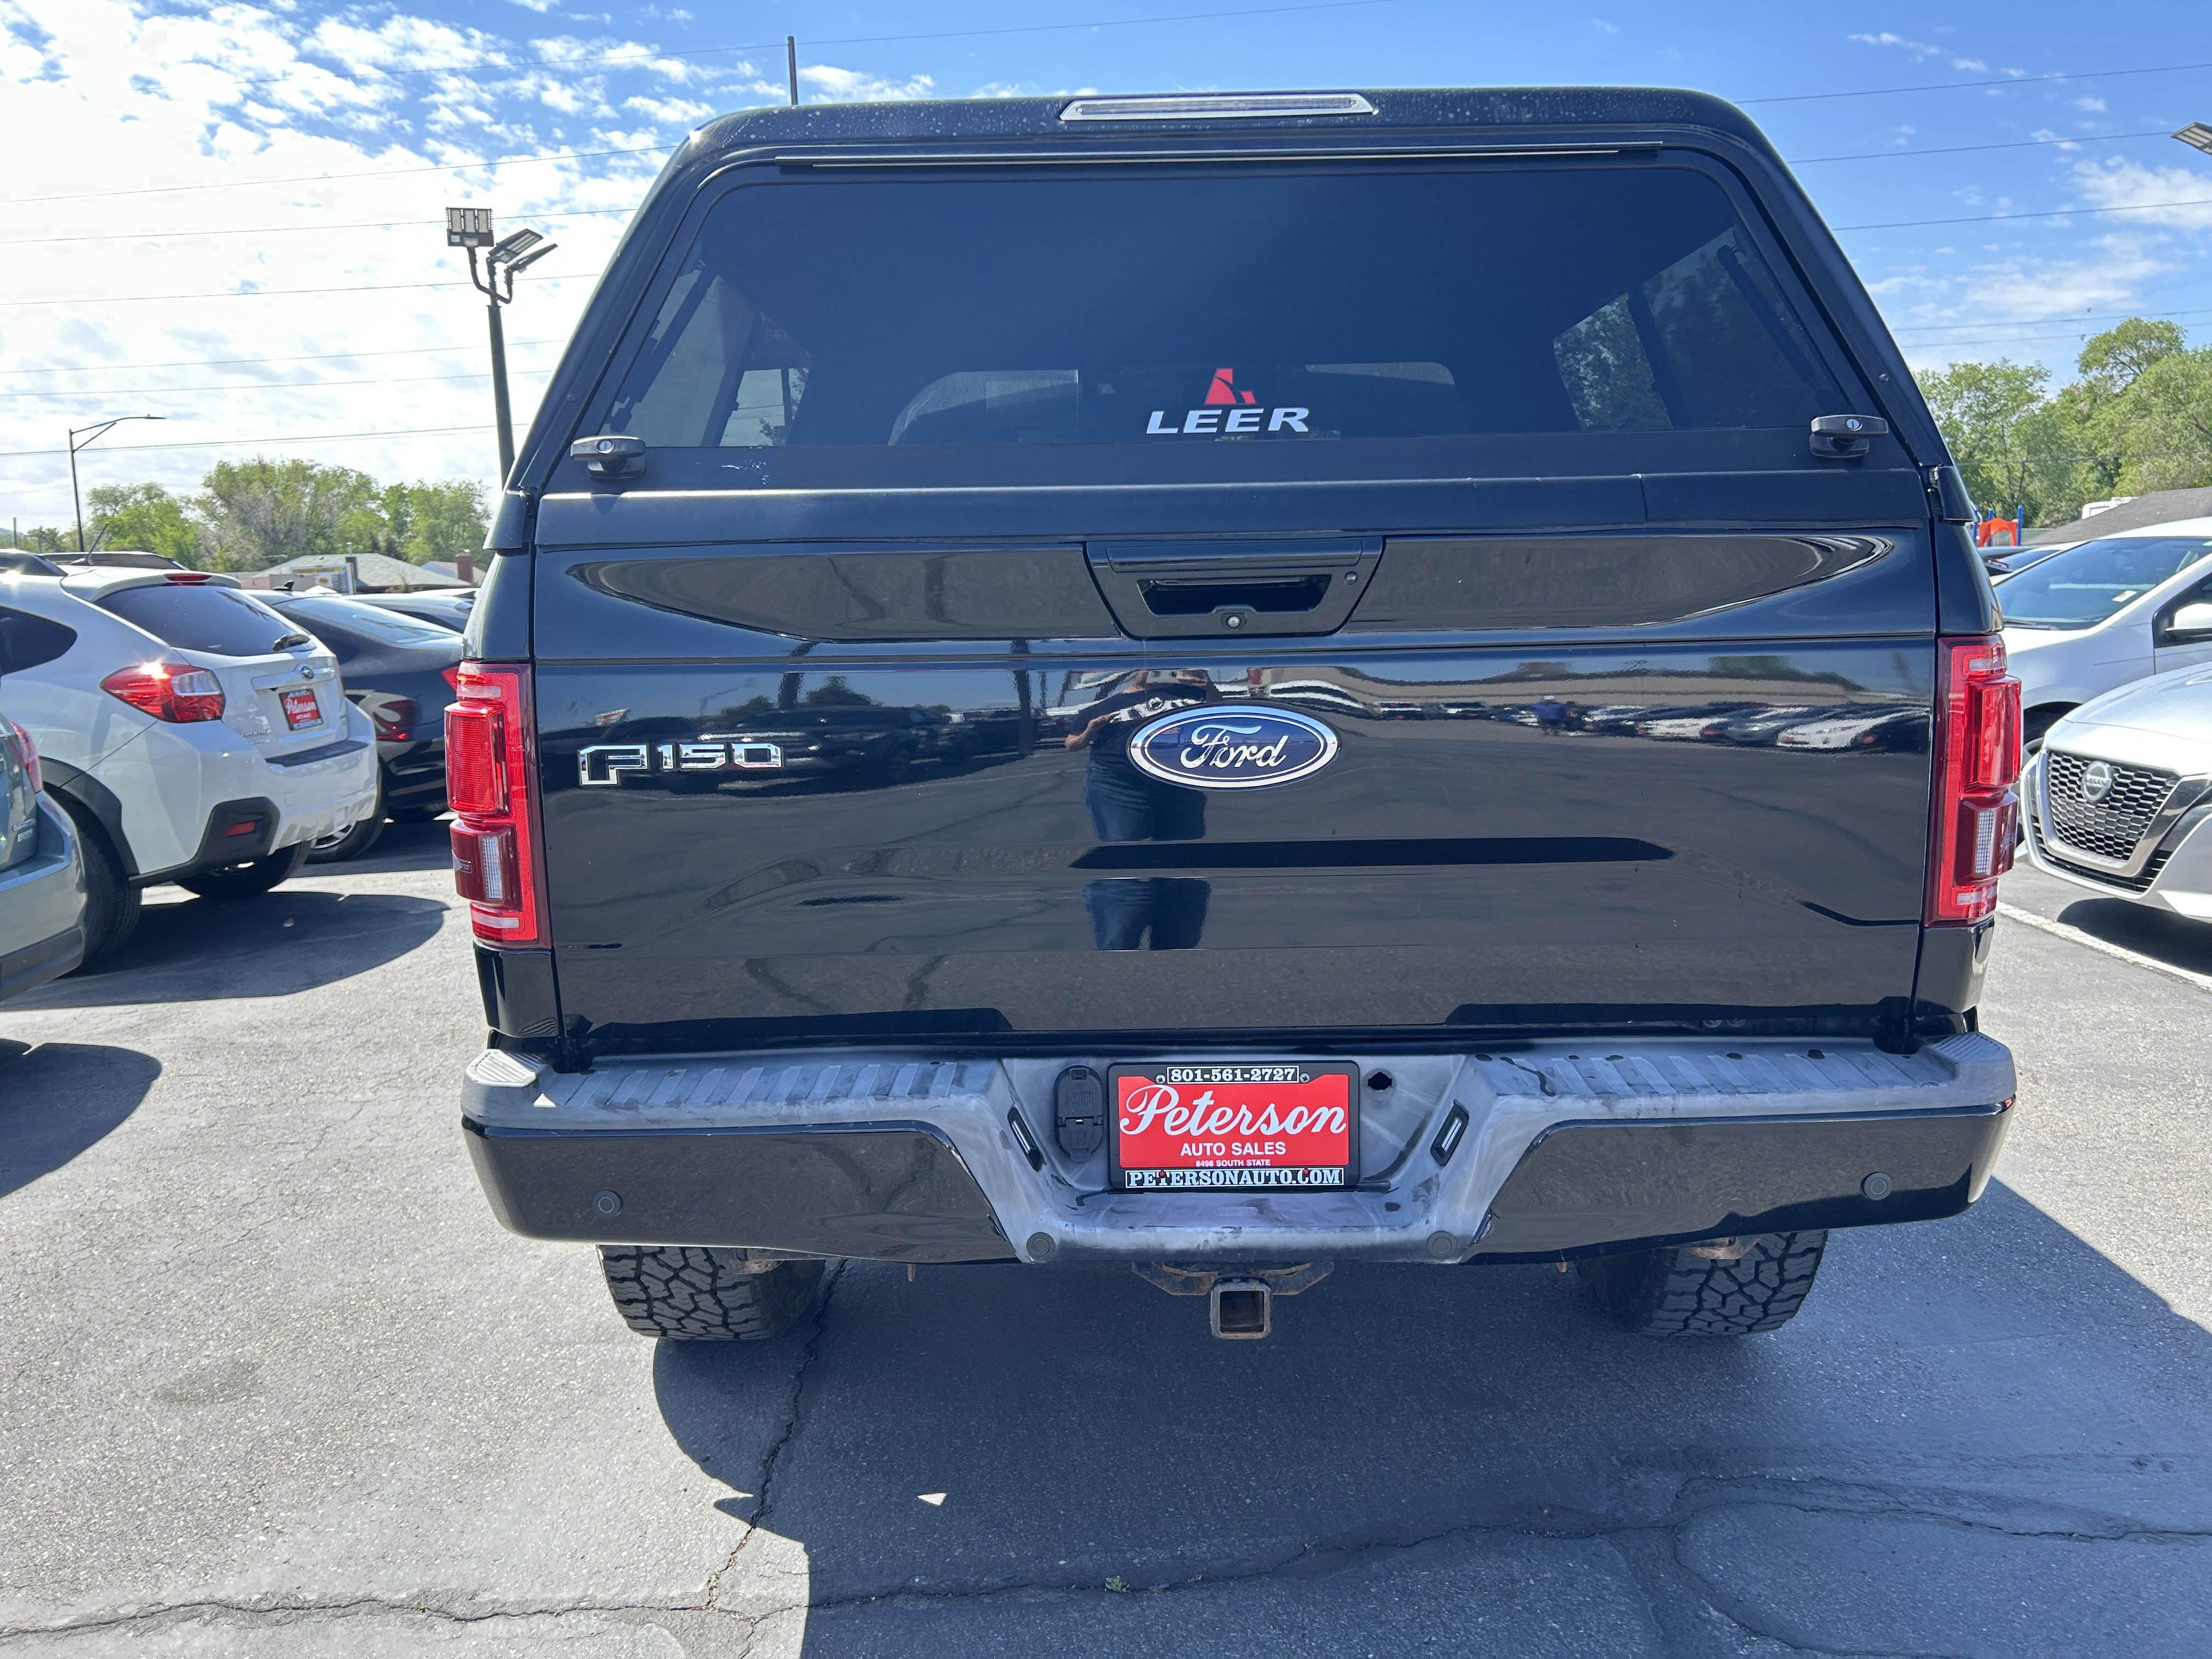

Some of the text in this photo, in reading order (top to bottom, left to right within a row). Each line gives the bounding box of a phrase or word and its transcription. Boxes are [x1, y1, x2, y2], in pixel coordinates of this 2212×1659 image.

[1147, 407, 1309, 434] LEER
[1180, 724, 1289, 769] Ford
[1171, 1067, 1295, 1082] 801-561-2727
[1120, 1084, 1346, 1136] Peterson
[1180, 1142, 1286, 1156] AUTO SALES
[1129, 1170, 1340, 1187] PETERSONAUTO.COM
